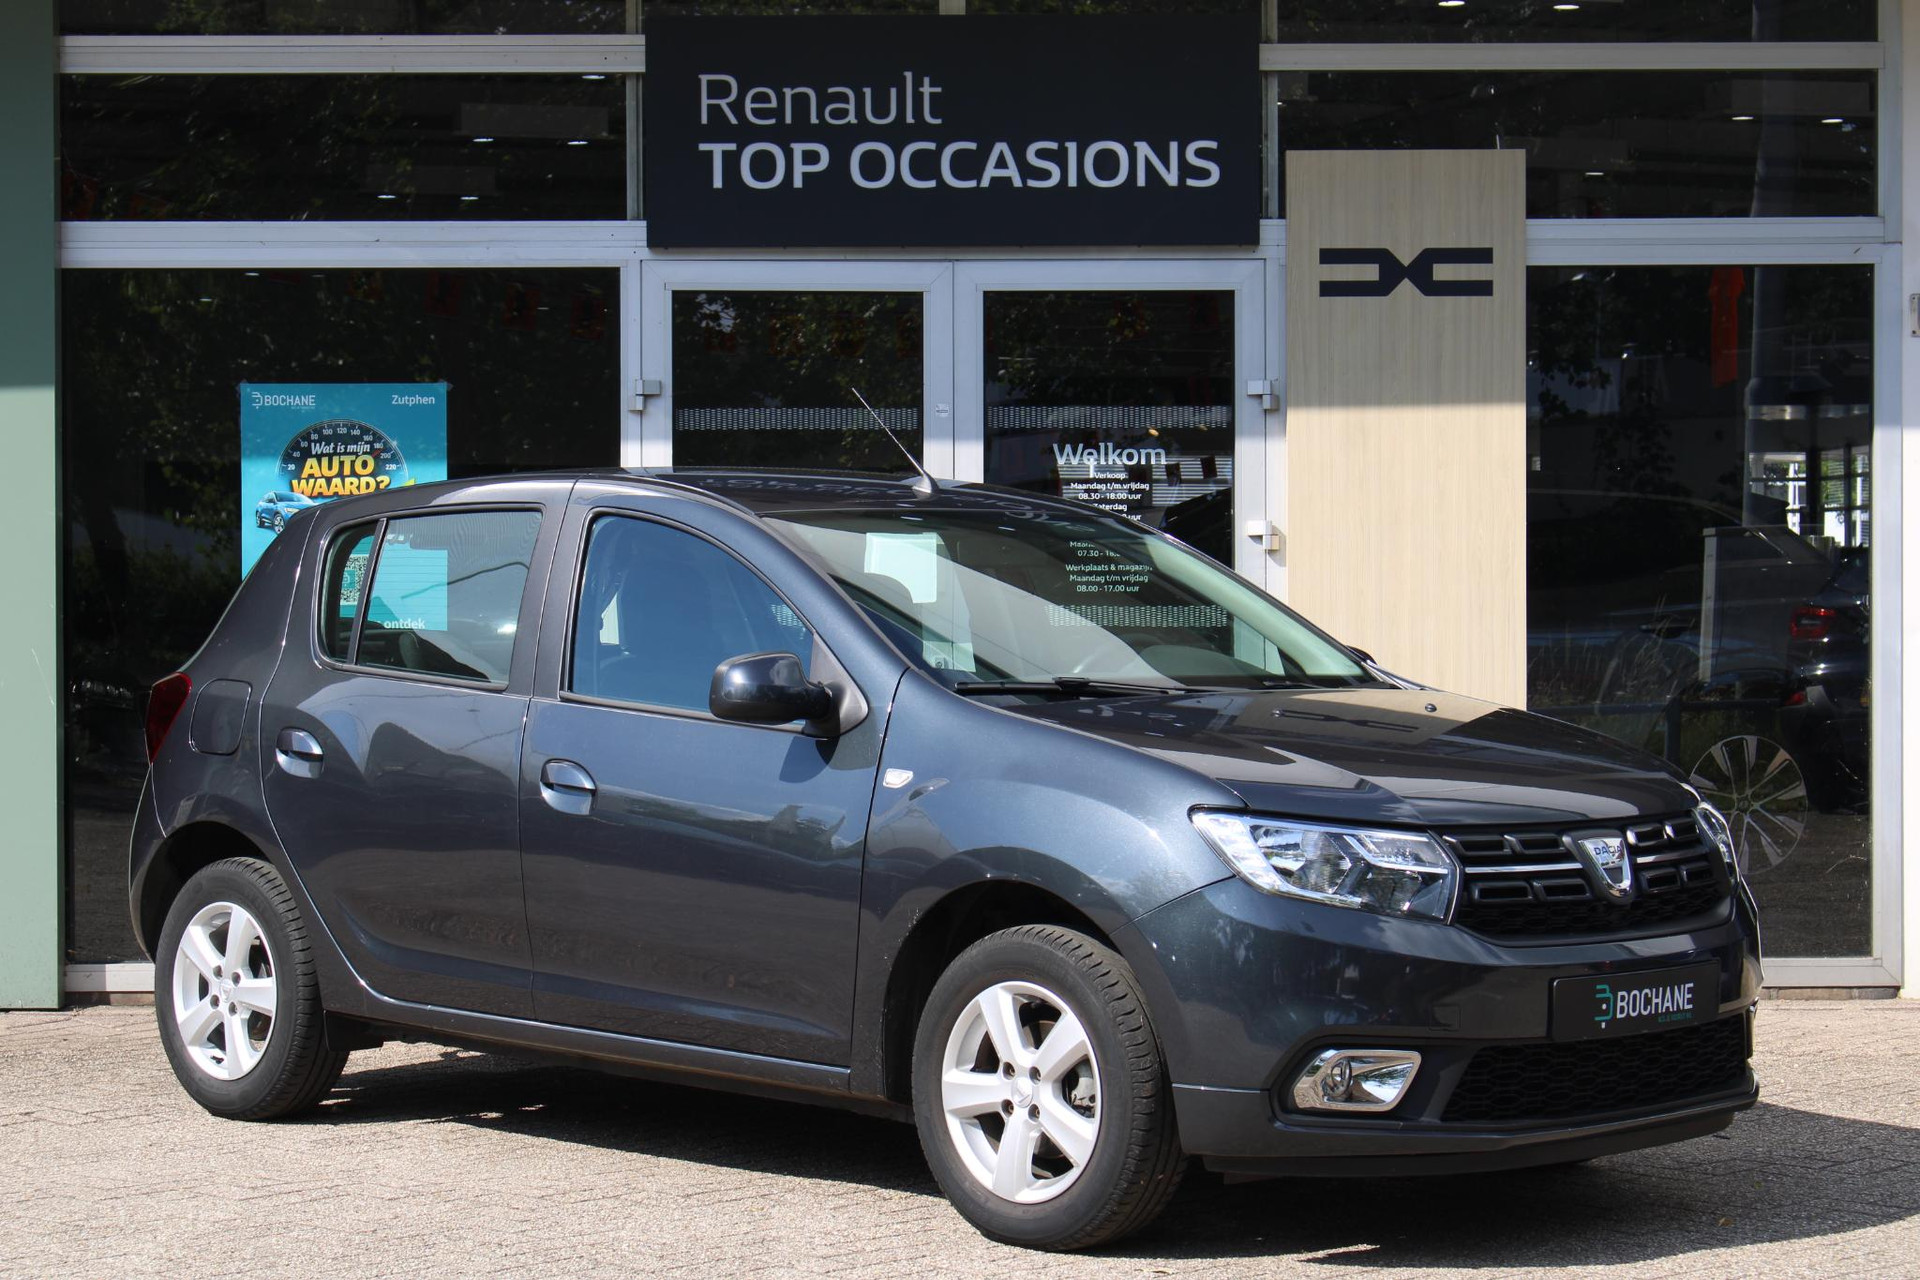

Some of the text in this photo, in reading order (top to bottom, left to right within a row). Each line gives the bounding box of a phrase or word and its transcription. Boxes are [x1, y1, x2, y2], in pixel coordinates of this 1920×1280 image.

[698, 71, 942, 125] Renault
[698, 140, 1221, 189] TOP OCCASIONS
[265, 395, 316, 406] BOCHANE
[392, 395, 435, 406] Zutphen
[311, 441, 370, 455] Wat is mijn
[1053, 443, 1167, 465] Welkom
[302, 456, 375, 478] AUTO
[1094, 472, 1126, 480] Verkoop
[291, 476, 391, 497] WAARD?
[1070, 482, 1106, 490] Maandag
[1122, 482, 1149, 491] vrijdag
[1065, 564, 1109, 572] Werkplaats
[1070, 574, 1105, 583] Maandag
[1122, 574, 1149, 583] vrijdag
[384, 618, 425, 629] ontdek
[1616, 982, 1694, 1019] BOCHANE
